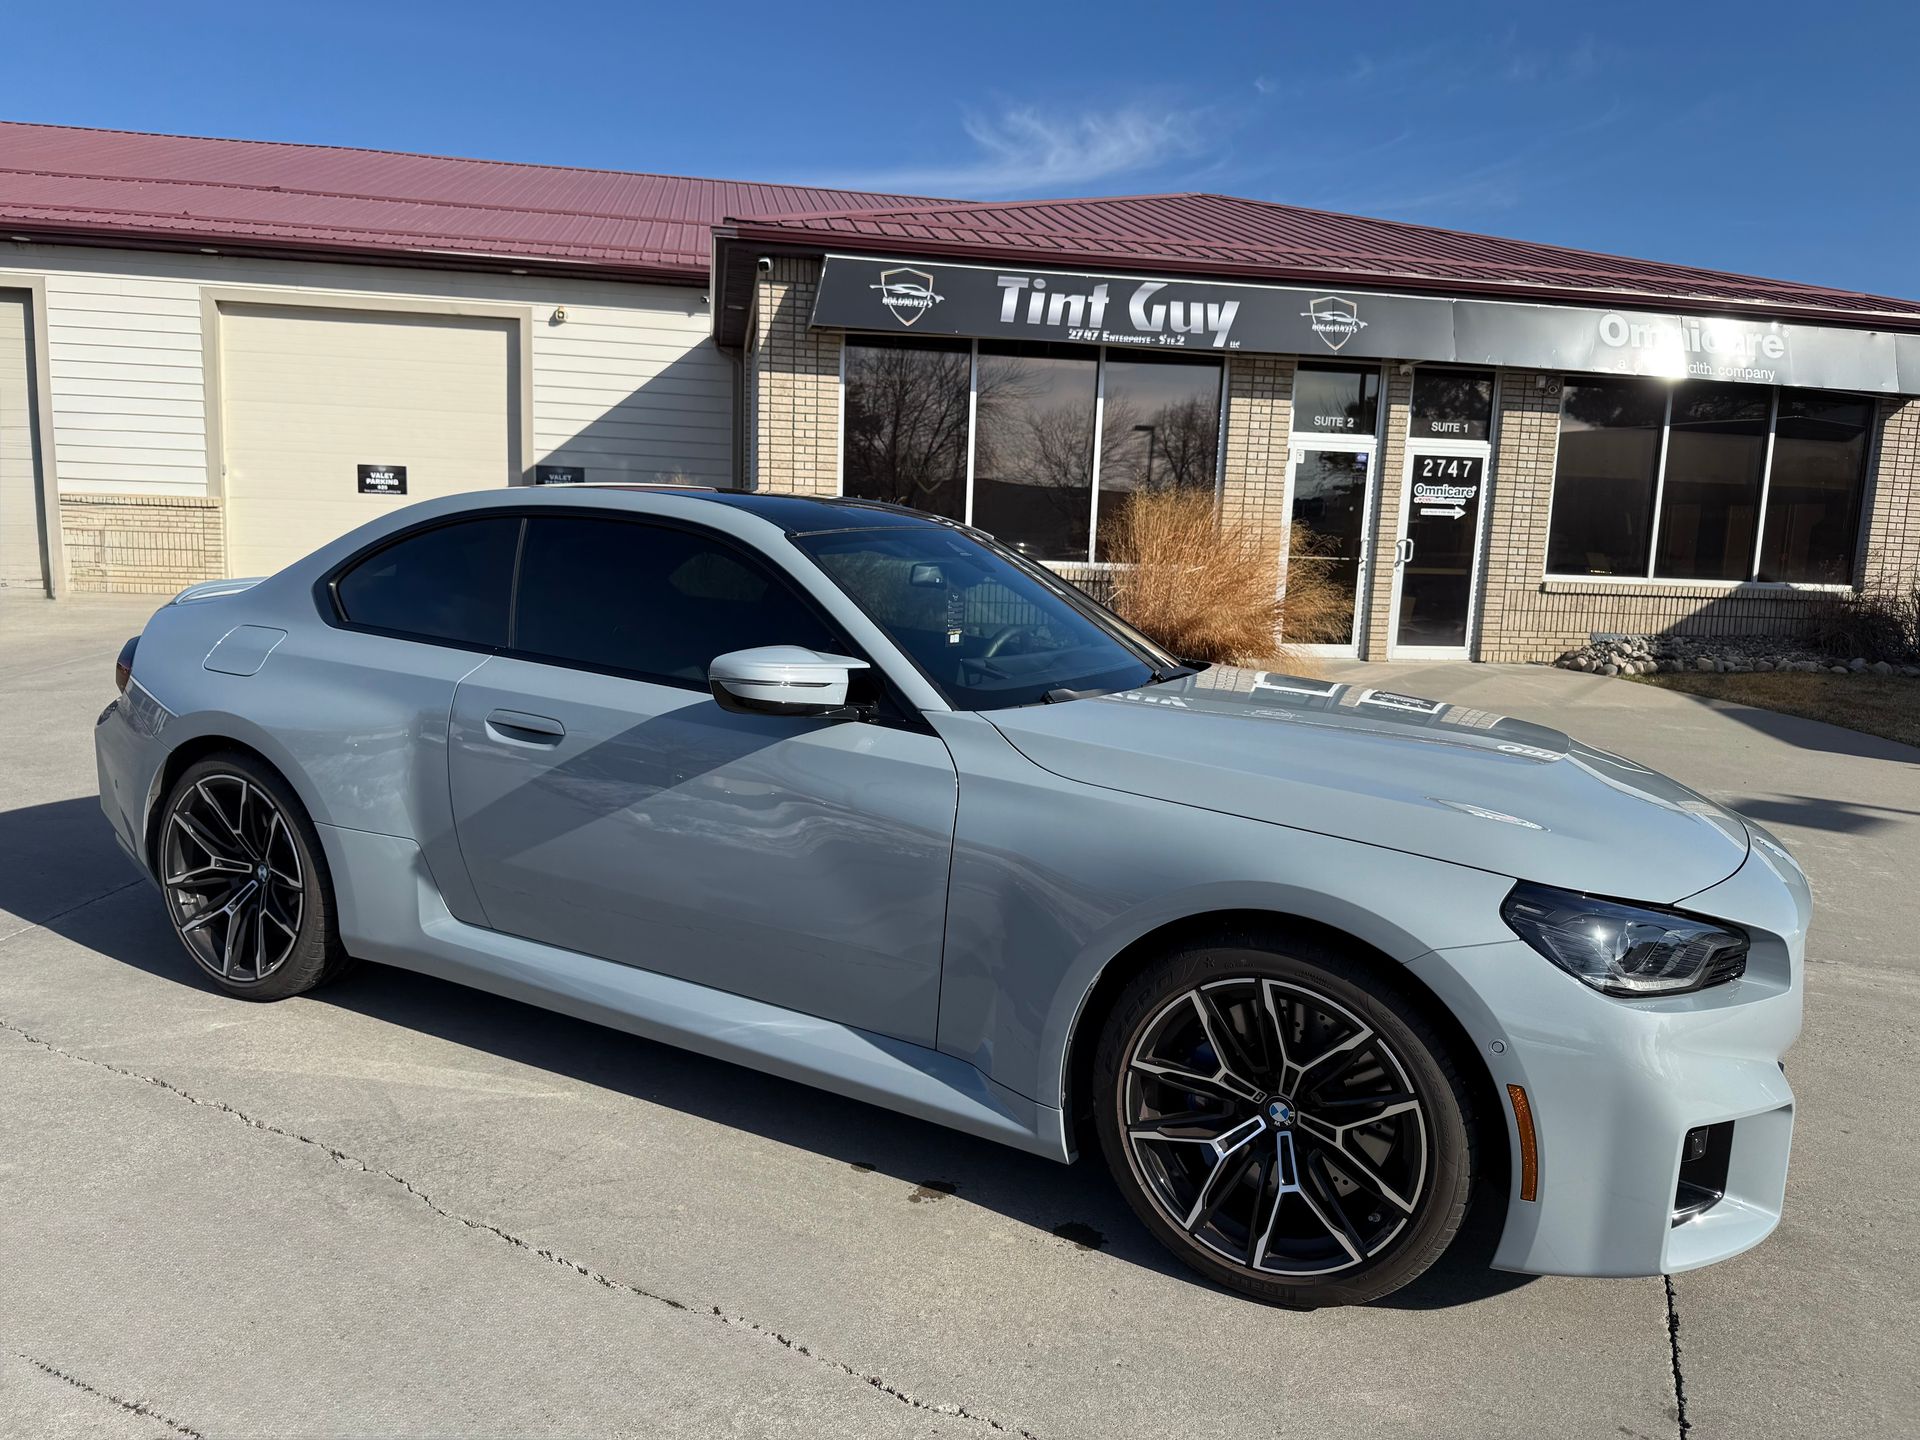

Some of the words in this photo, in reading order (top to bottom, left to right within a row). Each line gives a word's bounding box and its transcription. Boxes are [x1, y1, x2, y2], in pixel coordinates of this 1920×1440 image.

[997, 276, 1109, 328] Tint
[1129, 282, 1240, 347] Guy
[1068, 328, 1099, 340] 2747
[1718, 366, 1776, 382] company
[1313, 415, 1344, 427] SUITE
[1347, 417, 1354, 428] 2
[1431, 421, 1460, 433] SUITE
[1463, 423, 1469, 433] 1
[1422, 458, 1473, 478] 2747
[366, 478, 399, 486] PARKING
[1414, 484, 1475, 498] Omnicare
